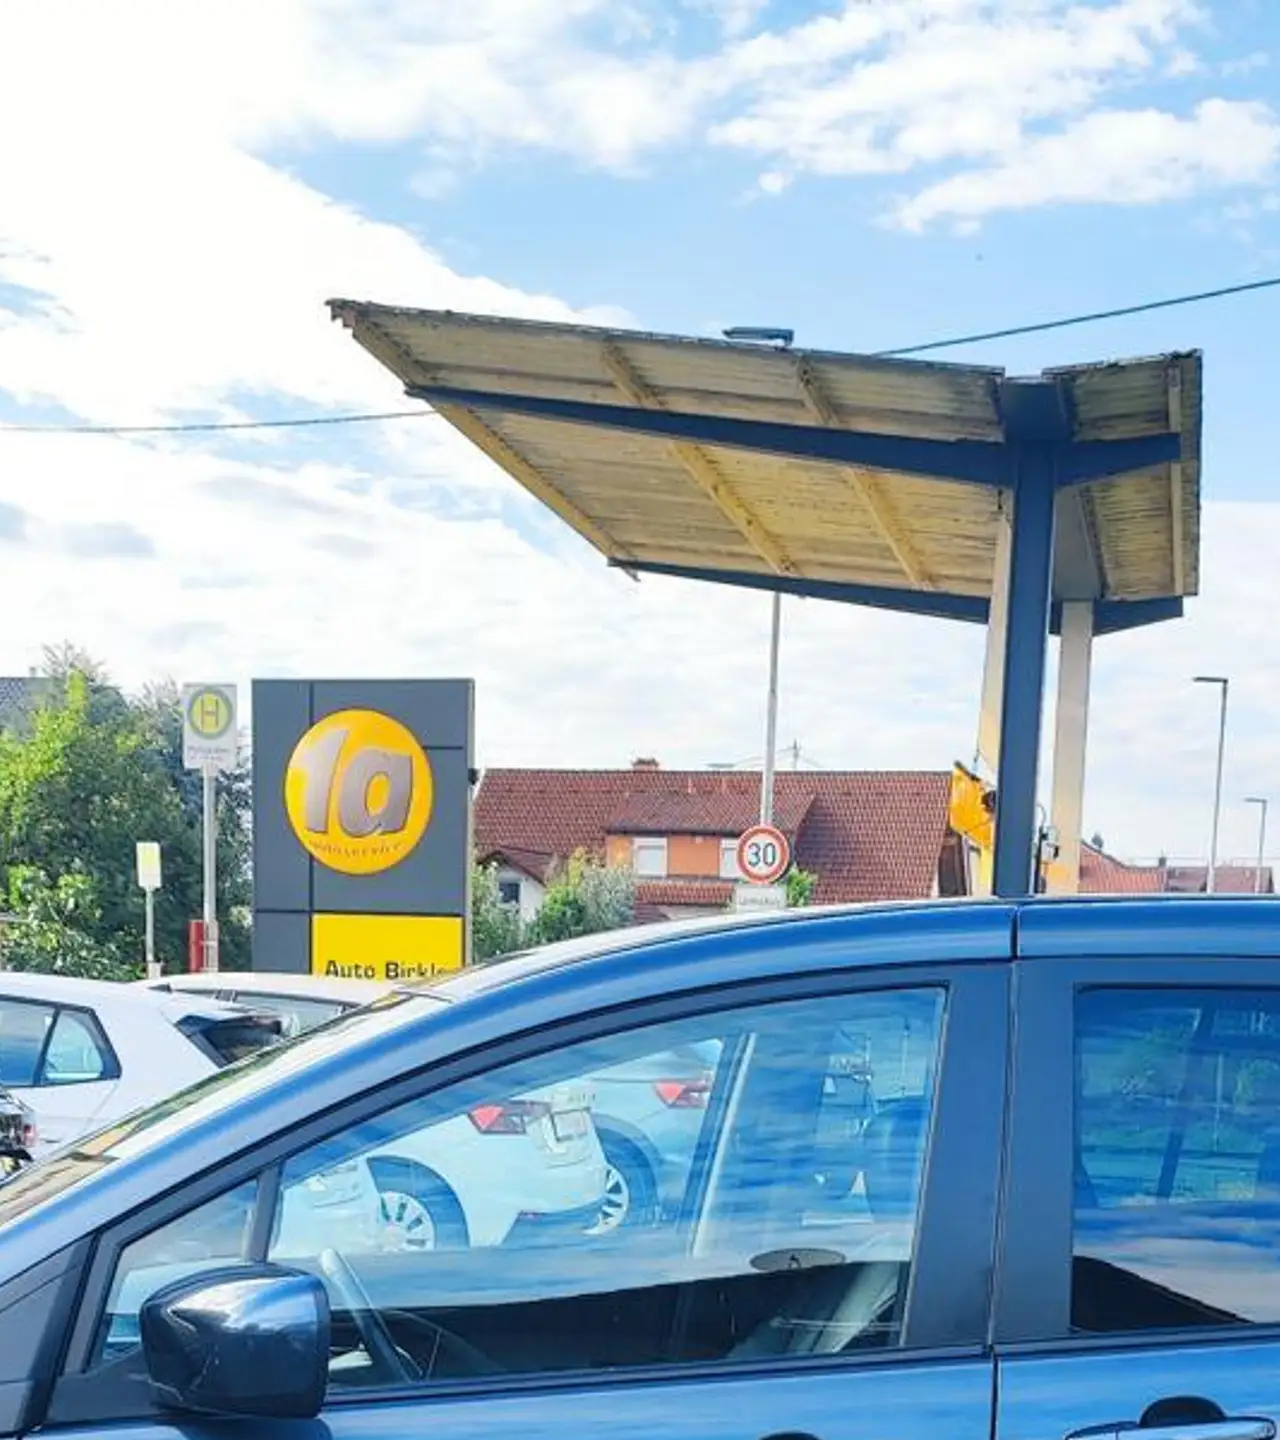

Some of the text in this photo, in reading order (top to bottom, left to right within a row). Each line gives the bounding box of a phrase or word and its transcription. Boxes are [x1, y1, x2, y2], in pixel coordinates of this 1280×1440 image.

[200, 700, 219, 728] H
[304, 728, 413, 838] 1a
[747, 842, 776, 867] 30
[325, 960, 376, 979] Auto
